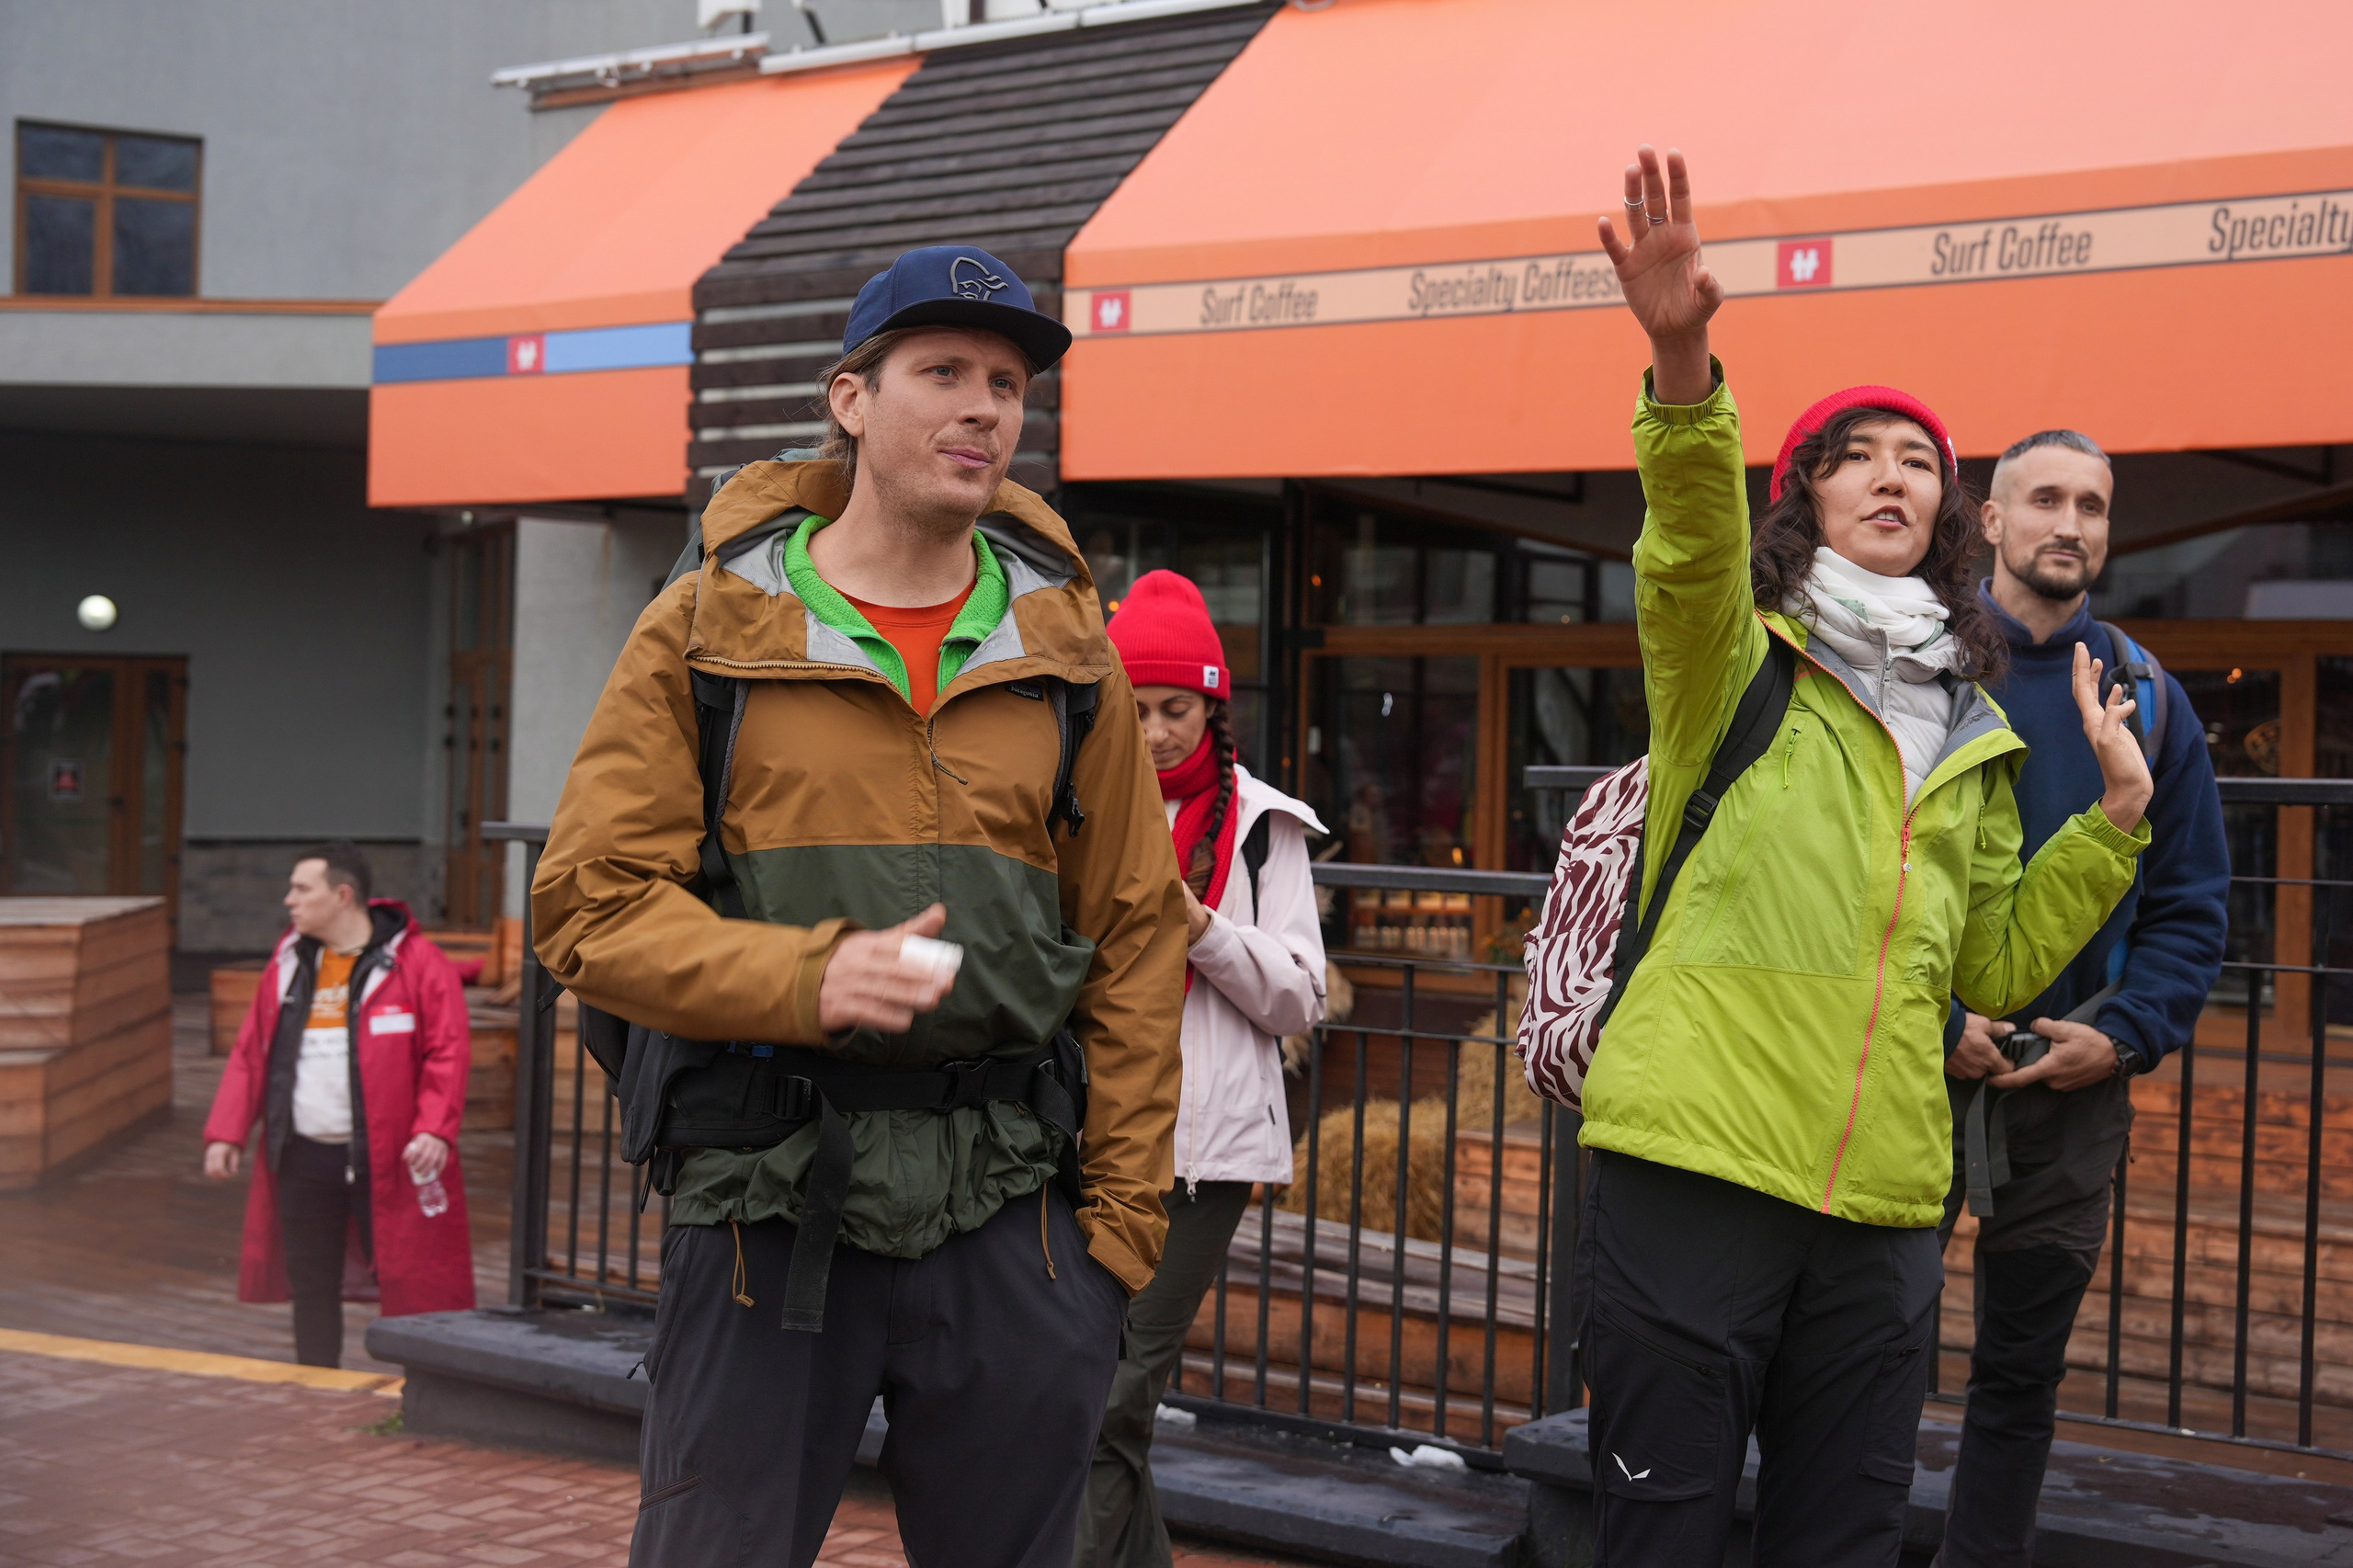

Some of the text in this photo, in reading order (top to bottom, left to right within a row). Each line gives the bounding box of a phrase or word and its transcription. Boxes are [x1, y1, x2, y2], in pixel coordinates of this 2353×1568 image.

[1931, 222, 2092, 276] Surf Coffee
[1199, 279, 1319, 324] Surf Coffee
[1408, 263, 1517, 317] Specialty
